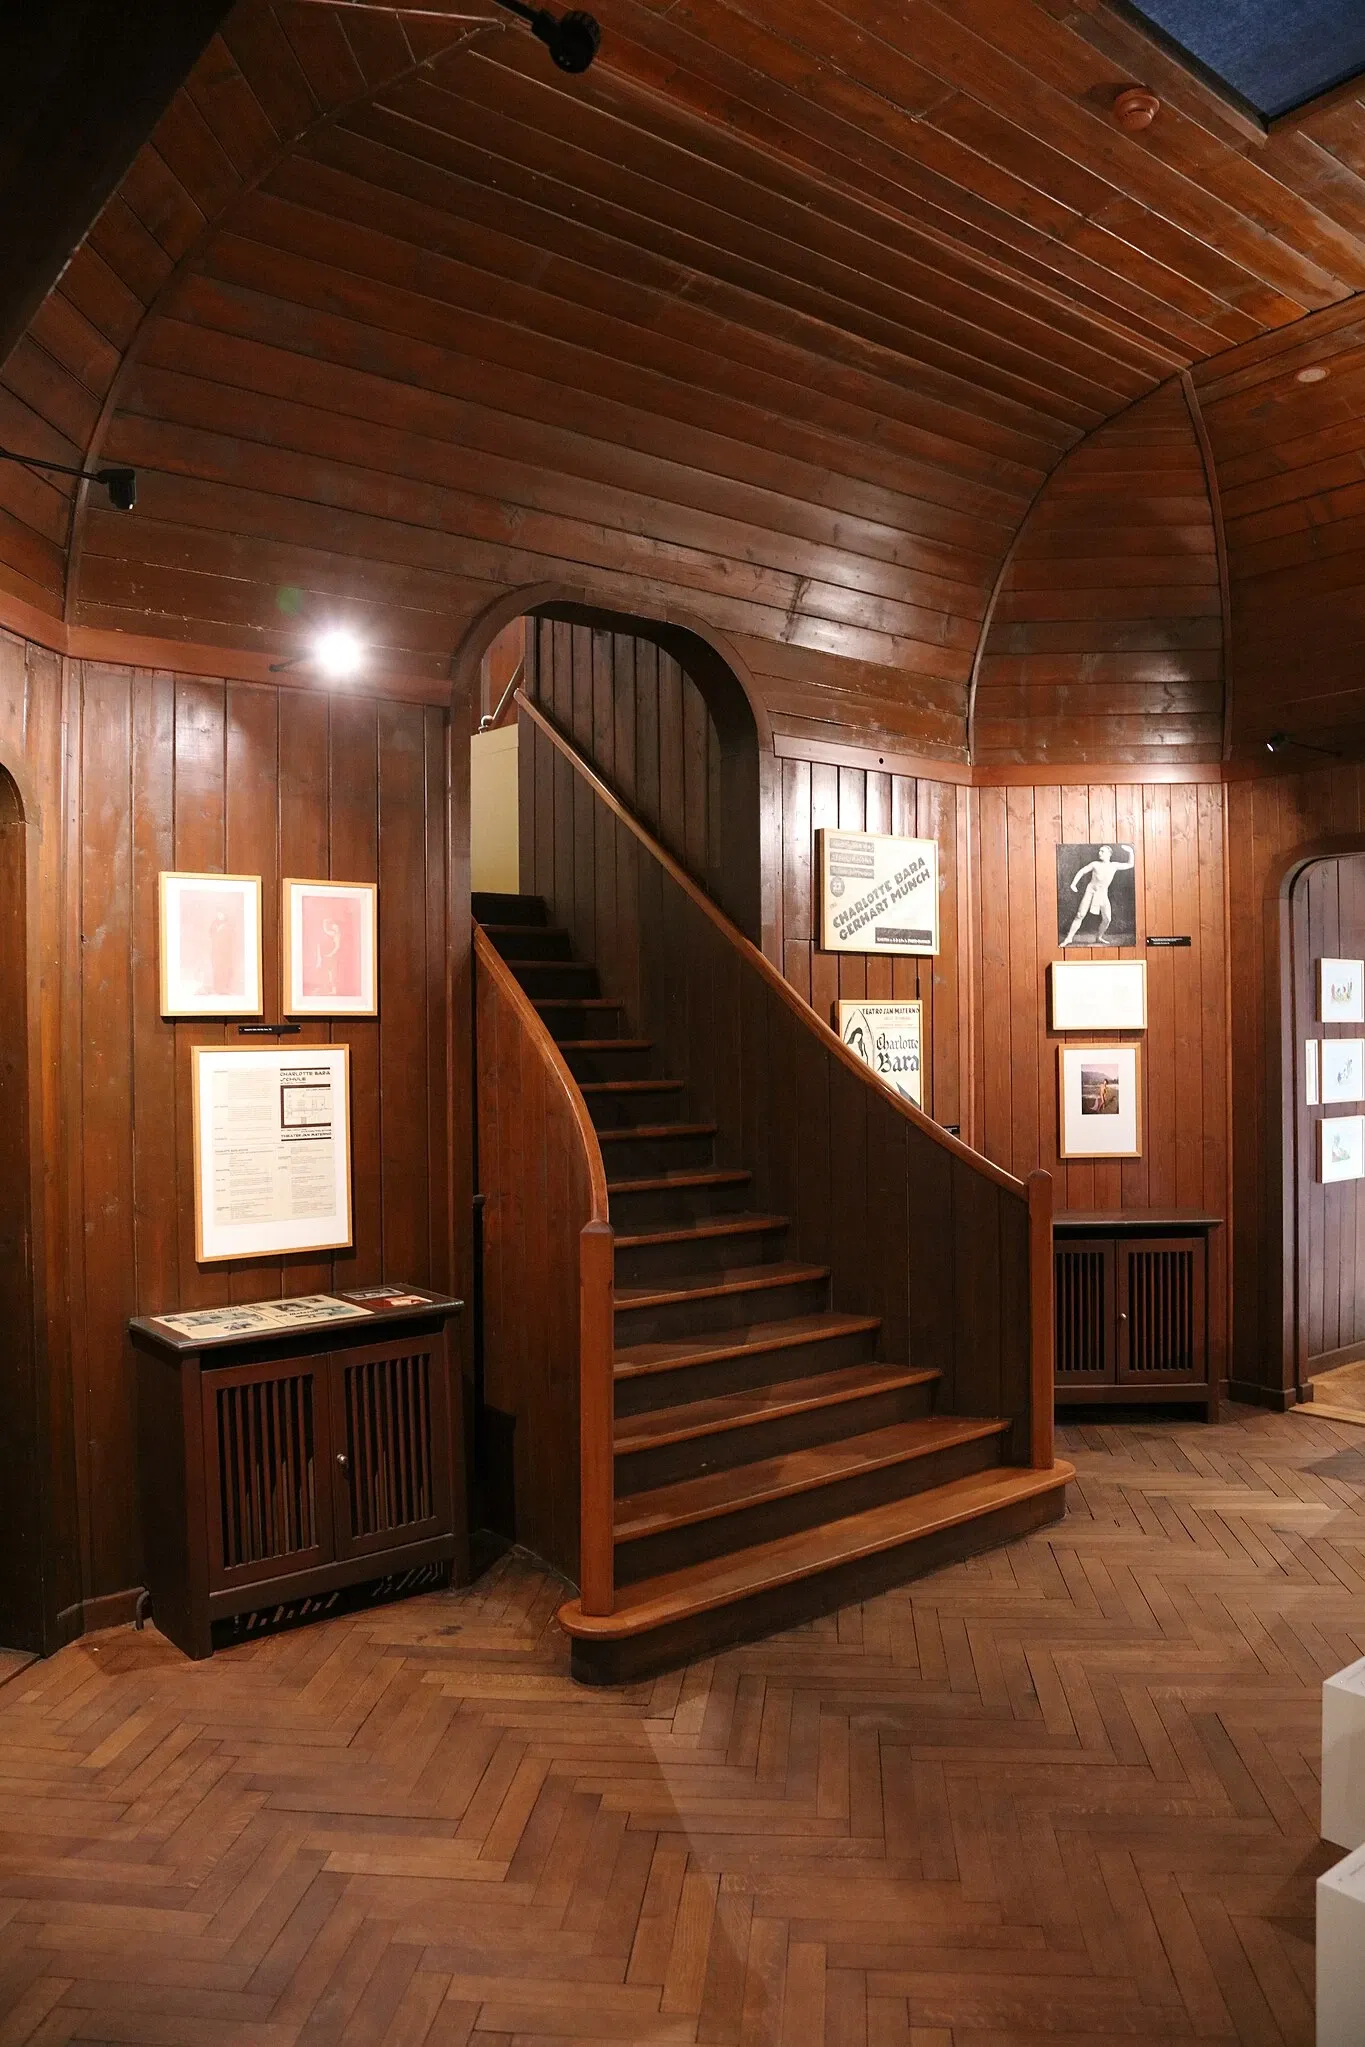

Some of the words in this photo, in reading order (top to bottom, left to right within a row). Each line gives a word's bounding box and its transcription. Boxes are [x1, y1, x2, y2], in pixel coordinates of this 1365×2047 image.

[833, 880, 892, 928] CHARLOTTE
[894, 857, 926, 885] BARA
[839, 898, 888, 941] GERHART
[876, 1032, 918, 1051] Charlotte
[877, 1052, 919, 1073] Bara
